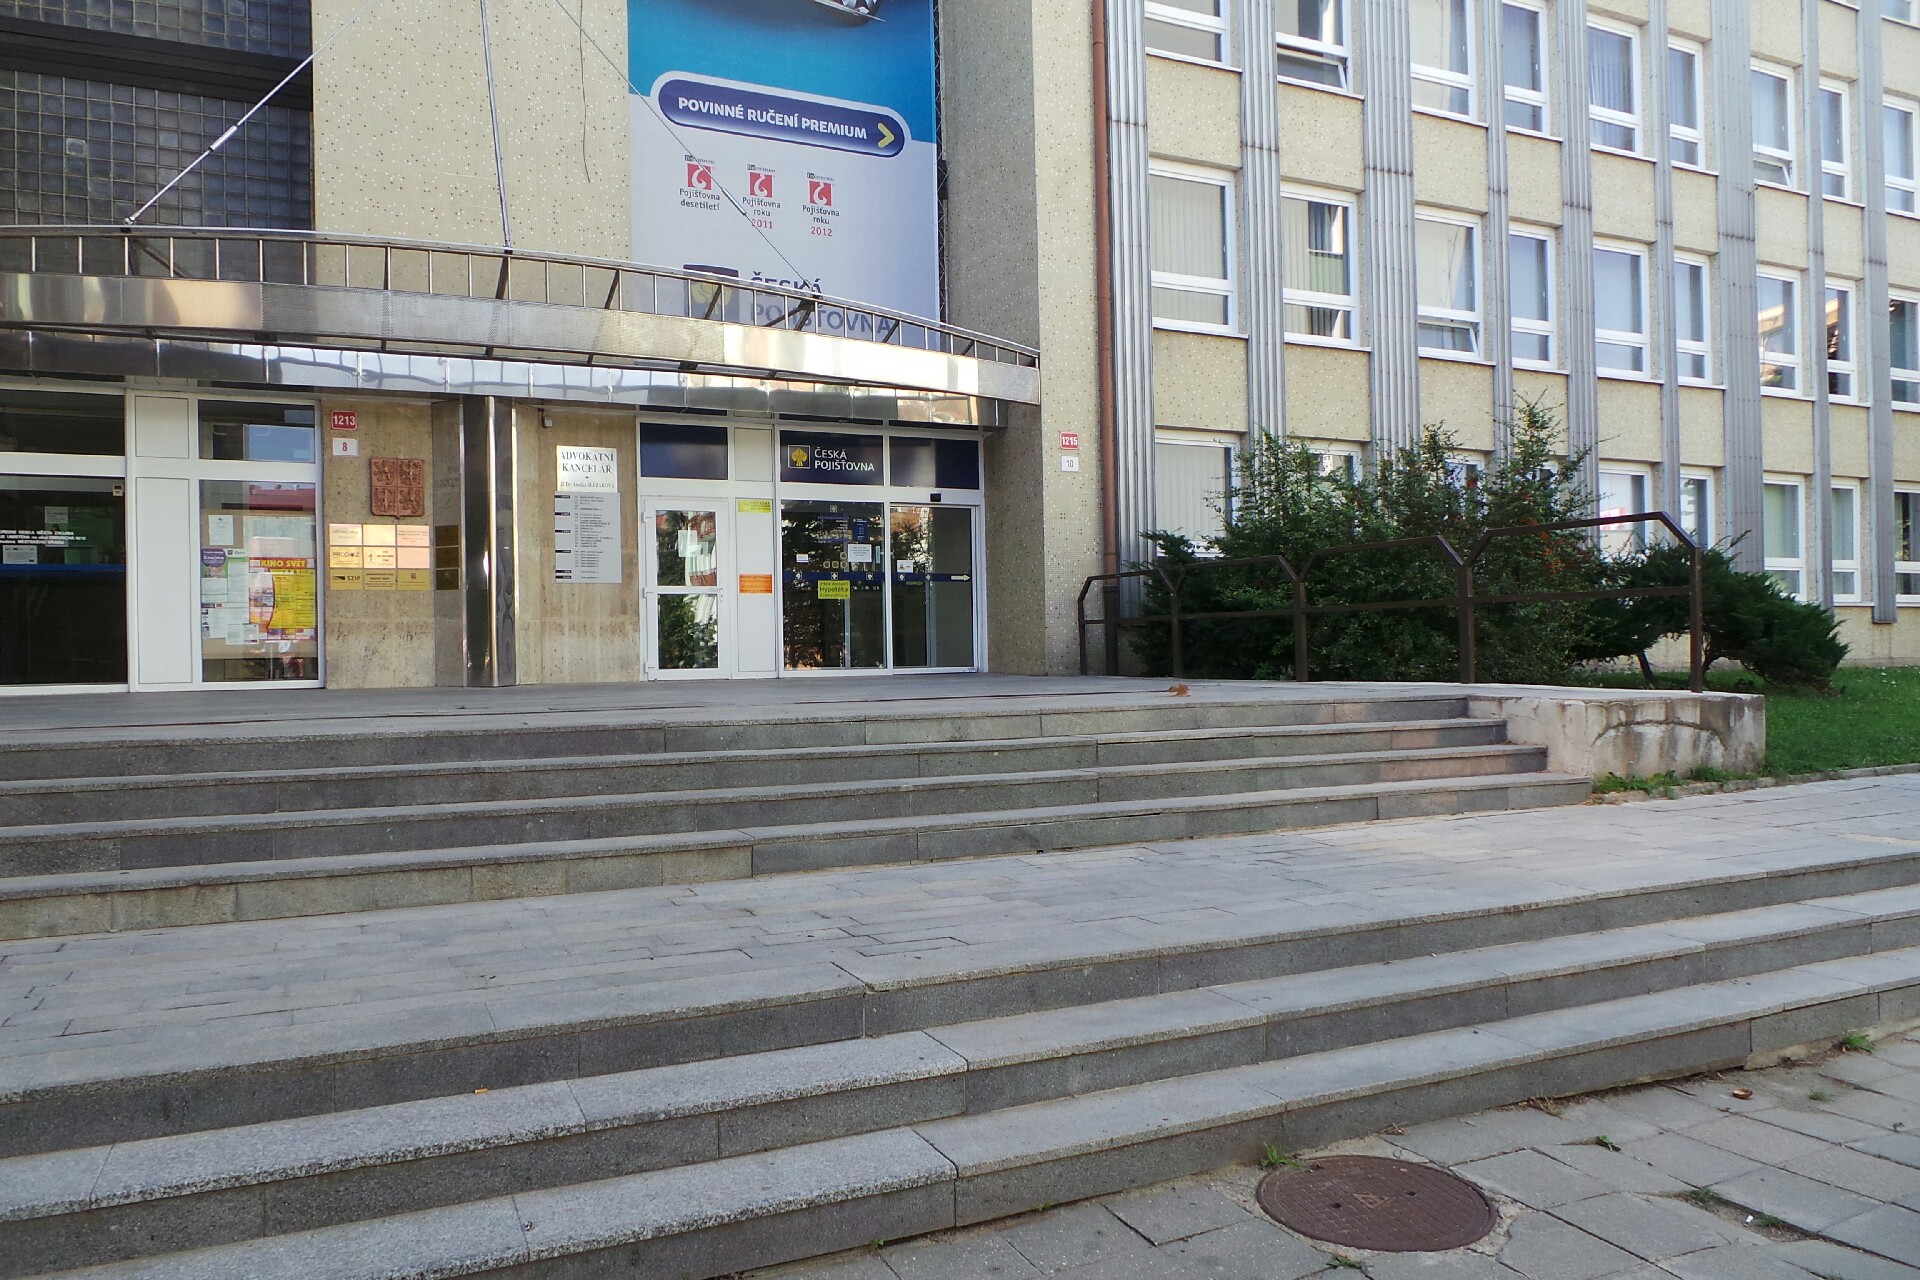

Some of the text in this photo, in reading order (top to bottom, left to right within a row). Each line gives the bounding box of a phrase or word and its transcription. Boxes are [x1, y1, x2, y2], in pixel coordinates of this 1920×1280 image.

[678, 97, 867, 139] POVINNÉ RUČENÍ PREMIUM
[679, 188, 721, 201] Pojišťovna
[680, 199, 720, 211] desetiletí
[742, 196, 781, 209] Pojišťovna
[753, 208, 770, 217] roku
[802, 204, 840, 217] Pojišťovna
[751, 218, 773, 229] 2011
[813, 216, 830, 225] roku
[811, 226, 833, 237] 2012
[333, 415, 356, 426] 1213
[1061, 436, 1078, 446] 1215
[342, 442, 348, 452] 8
[560, 450, 614, 462] ADVOKÁTNÍ
[814, 446, 848, 460] ČESKÁ
[562, 462, 612, 474] KANCELÁŘ
[814, 460, 875, 472] POJIŠŤOVNA
[1066, 459, 1074, 468] 10
[261, 559, 284, 567] KINO
